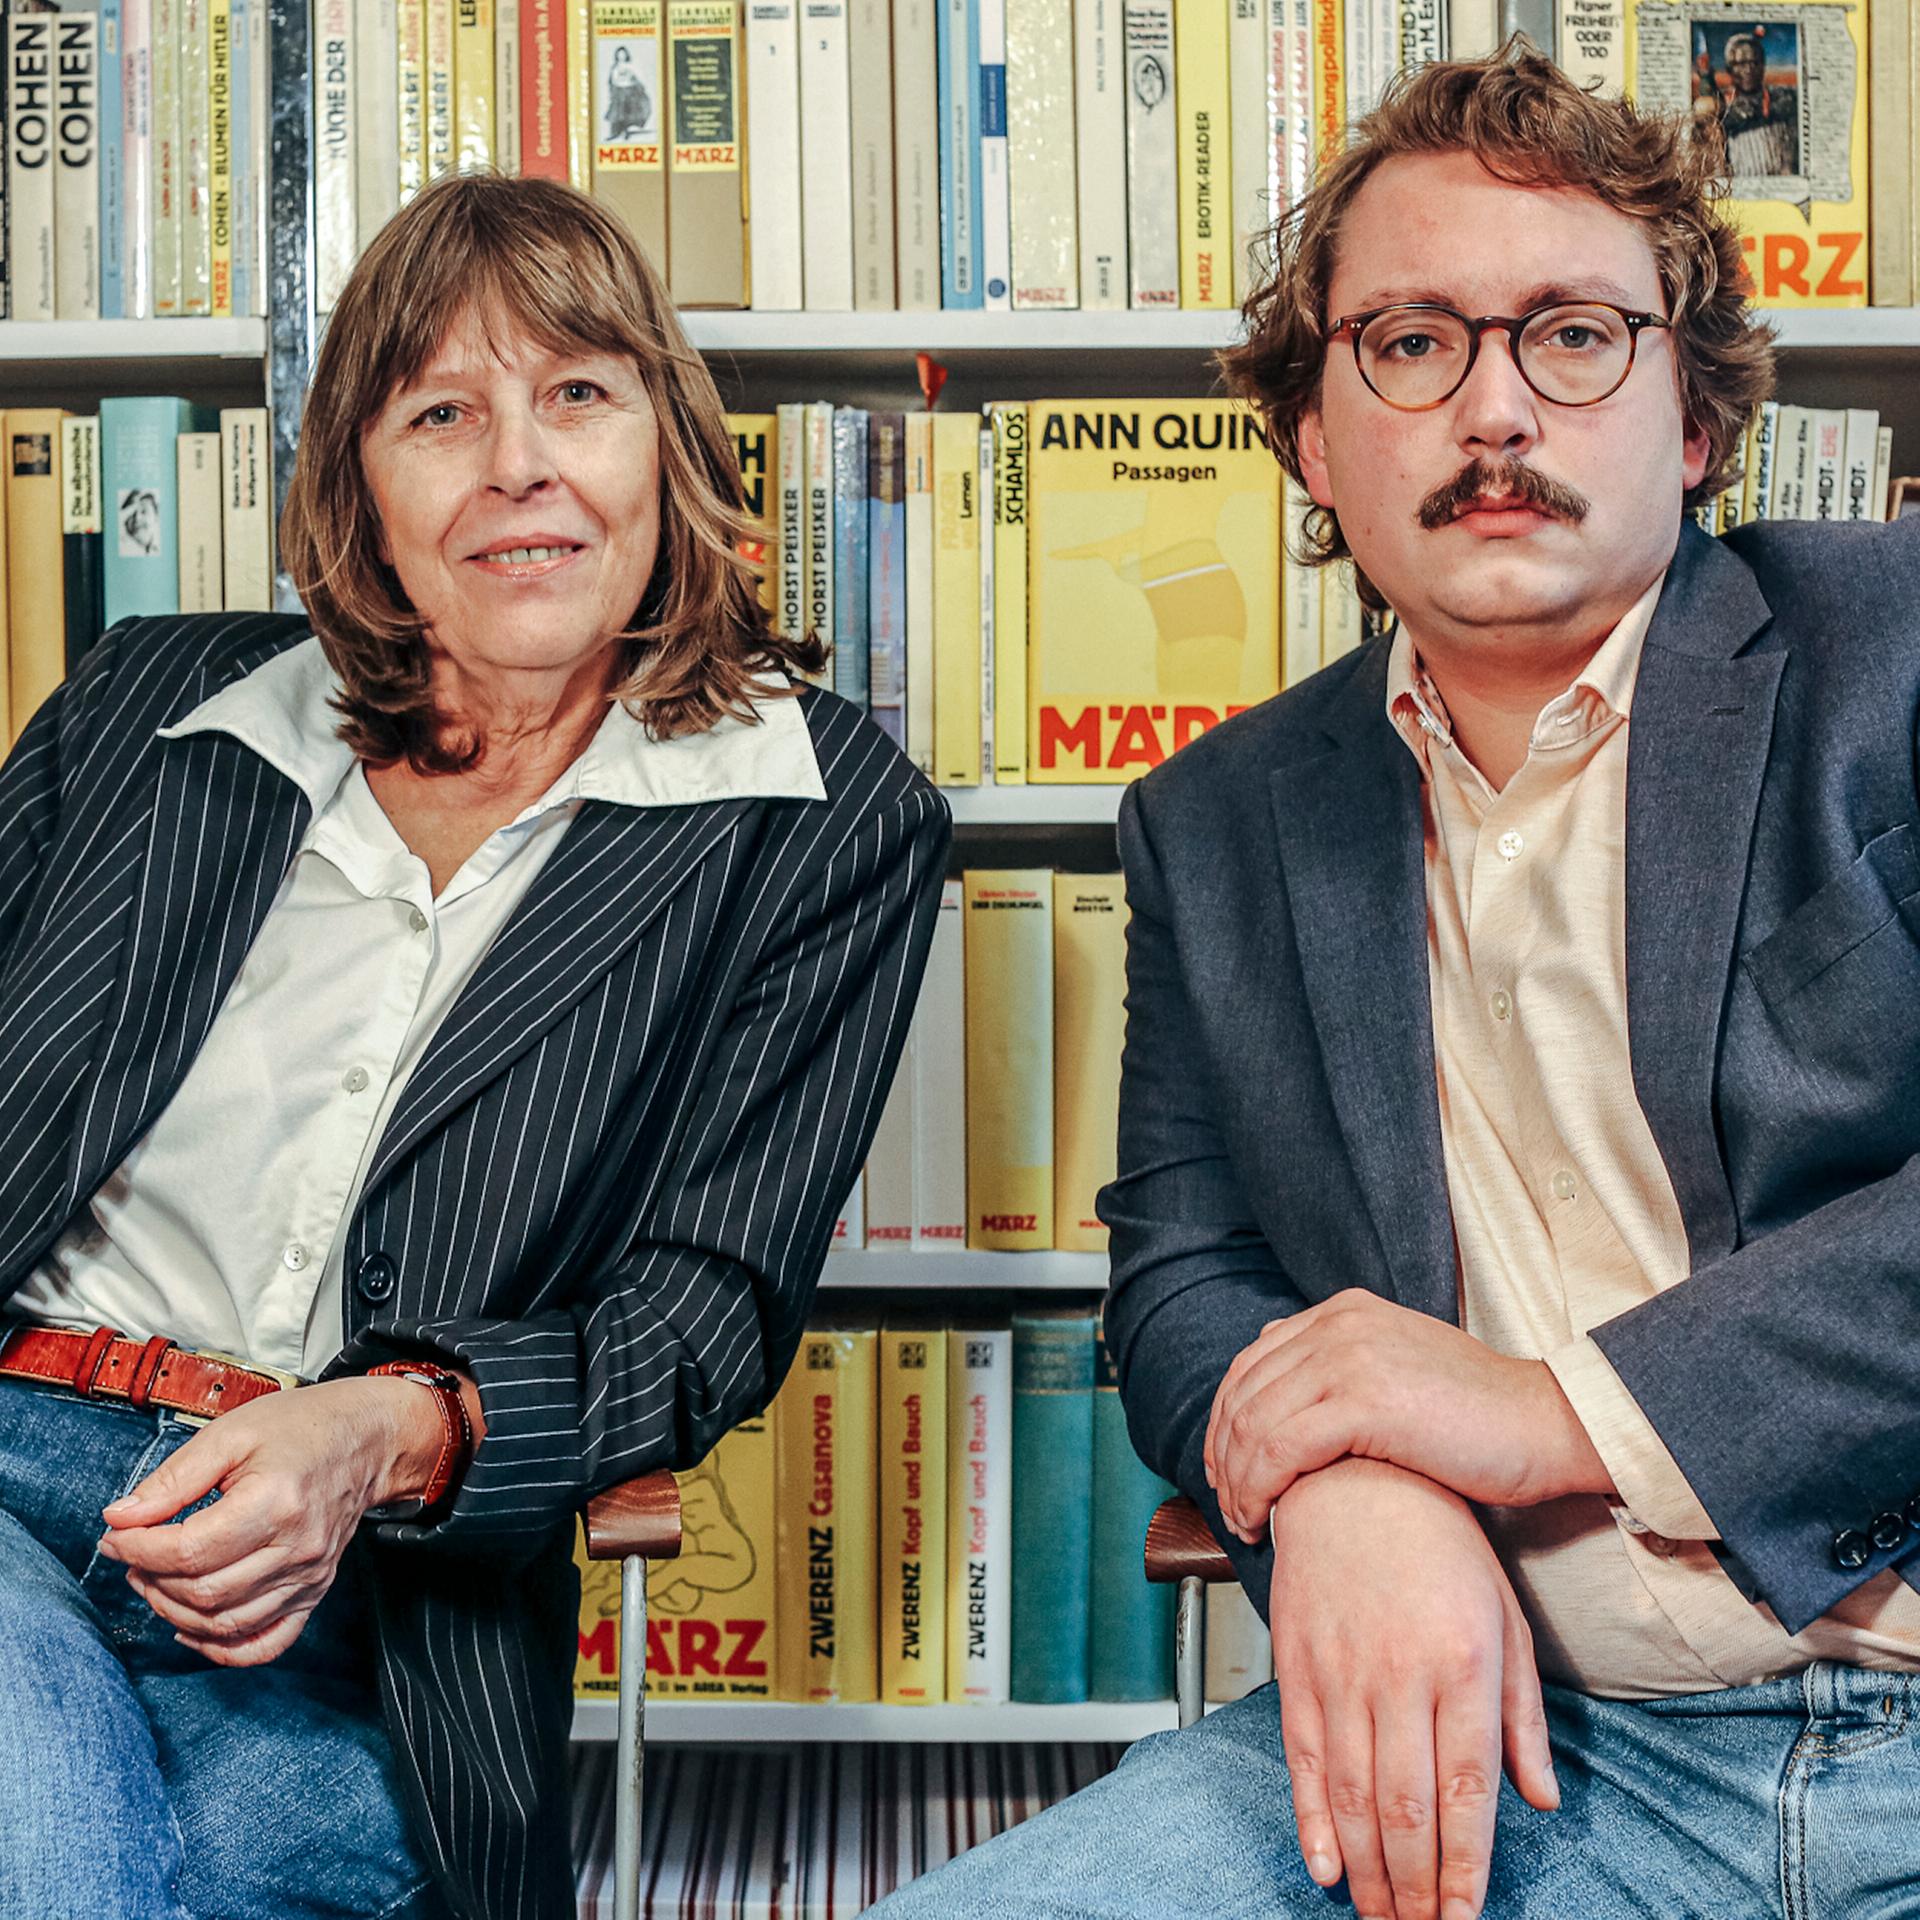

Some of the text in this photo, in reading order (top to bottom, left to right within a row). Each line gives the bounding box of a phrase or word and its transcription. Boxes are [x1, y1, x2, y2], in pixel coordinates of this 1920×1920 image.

[538, 13, 549, 28] in
[1575, 30, 1612, 42] ODER
[327, 40, 346, 83] DER
[1581, 46, 1608, 58] TOD
[16, 22, 49, 169] COHEN
[59, 21, 92, 168] COHEN
[210, 15, 229, 310] MÄRZ COHEN BLUMEN FÜR HITLER
[598, 146, 659, 164] MÄRZ
[675, 146, 736, 164] MÄRZ
[1195, 111, 1213, 302] MÄRZ EROTIK-READER
[1740, 232, 1863, 298] RZ
[1041, 414, 1270, 450] ANN QUIN
[959, 471, 972, 519] Lernen
[1006, 412, 1025, 525] SCHAMLOS
[1113, 462, 1217, 483] Passagen
[71, 497, 82, 516] Die
[785, 489, 798, 564] PEISKER
[812, 488, 826, 564] PEISKER
[785, 569, 799, 630] HORST
[812, 567, 826, 628] HORST
[1040, 705, 1250, 769] MÄR
[867, 1227, 912, 1240] MÄRZ
[920, 1226, 964, 1239] MÄRZ
[981, 1214, 1037, 1232] MÄRZ
[808, 1394, 833, 1517] Casanova
[902, 1394, 922, 1660] ZWERENZ Kopf und Bauch
[968, 1394, 988, 1659] ZWERENZ Kopf und Bauch
[809, 1526, 834, 1659] ZWERENZ
